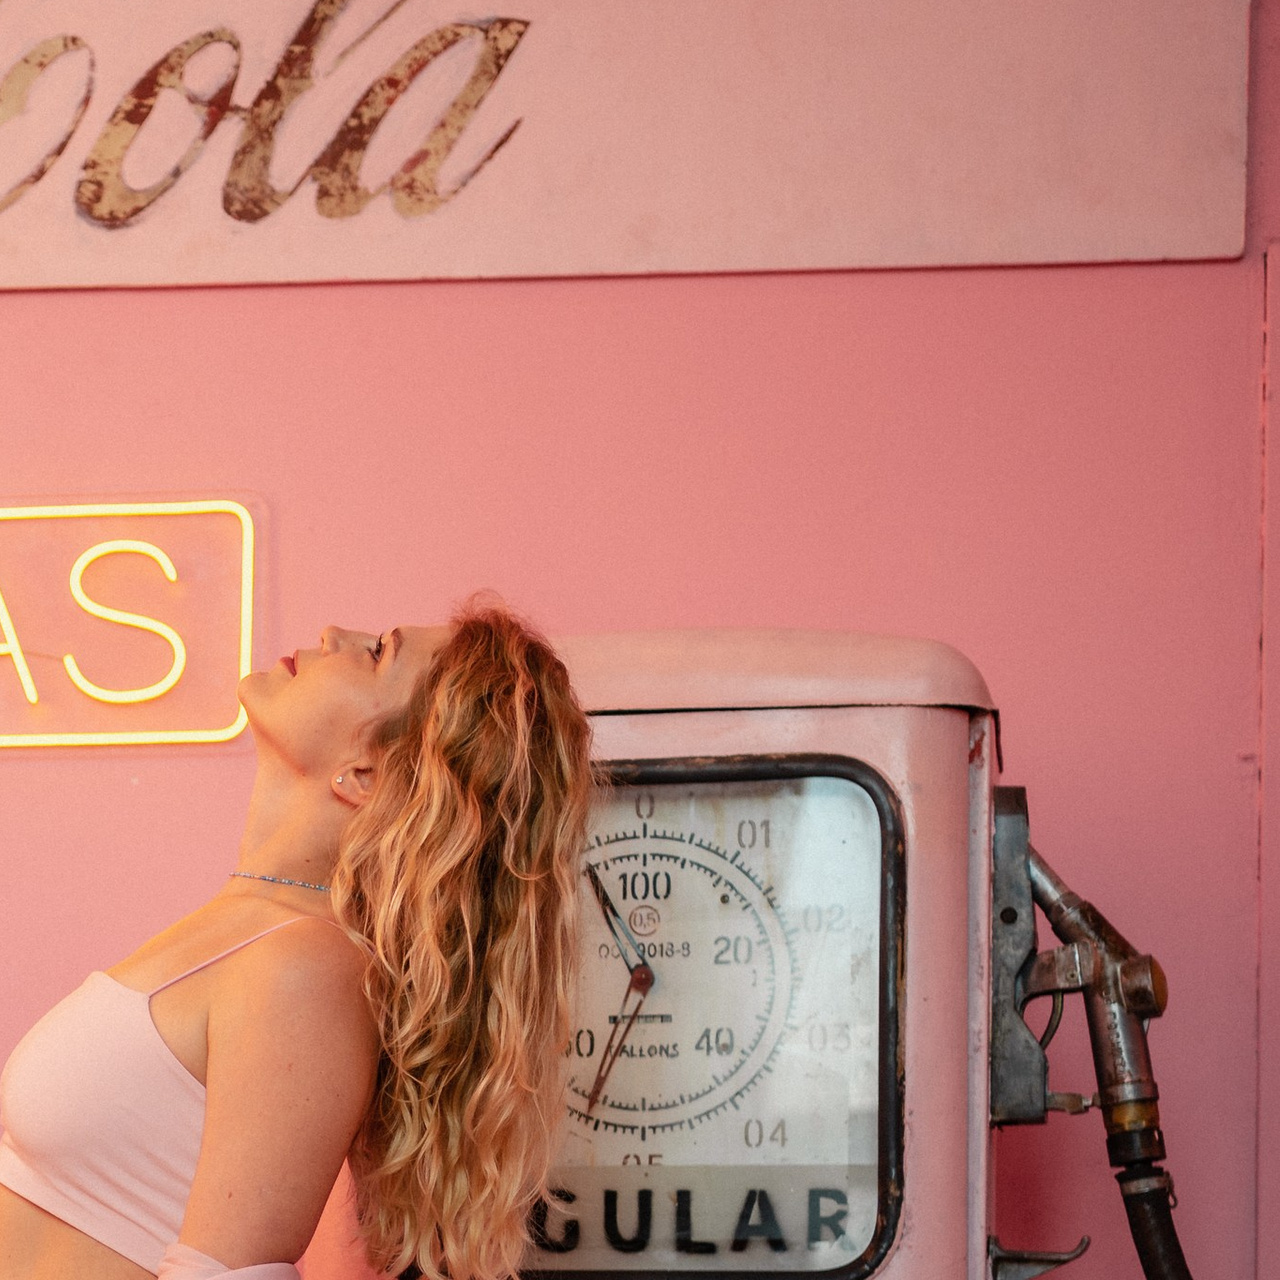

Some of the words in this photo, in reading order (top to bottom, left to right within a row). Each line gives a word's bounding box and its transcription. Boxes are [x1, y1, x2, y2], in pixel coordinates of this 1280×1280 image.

[737, 820, 771, 849] 01
[618, 872, 671, 900] 100
[713, 936, 753, 966] 20
[609, 1042, 680, 1059] ALLONS
[694, 1027, 735, 1057] 40
[743, 1118, 790, 1150] 04
[526, 1187, 857, 1255] GULAR
